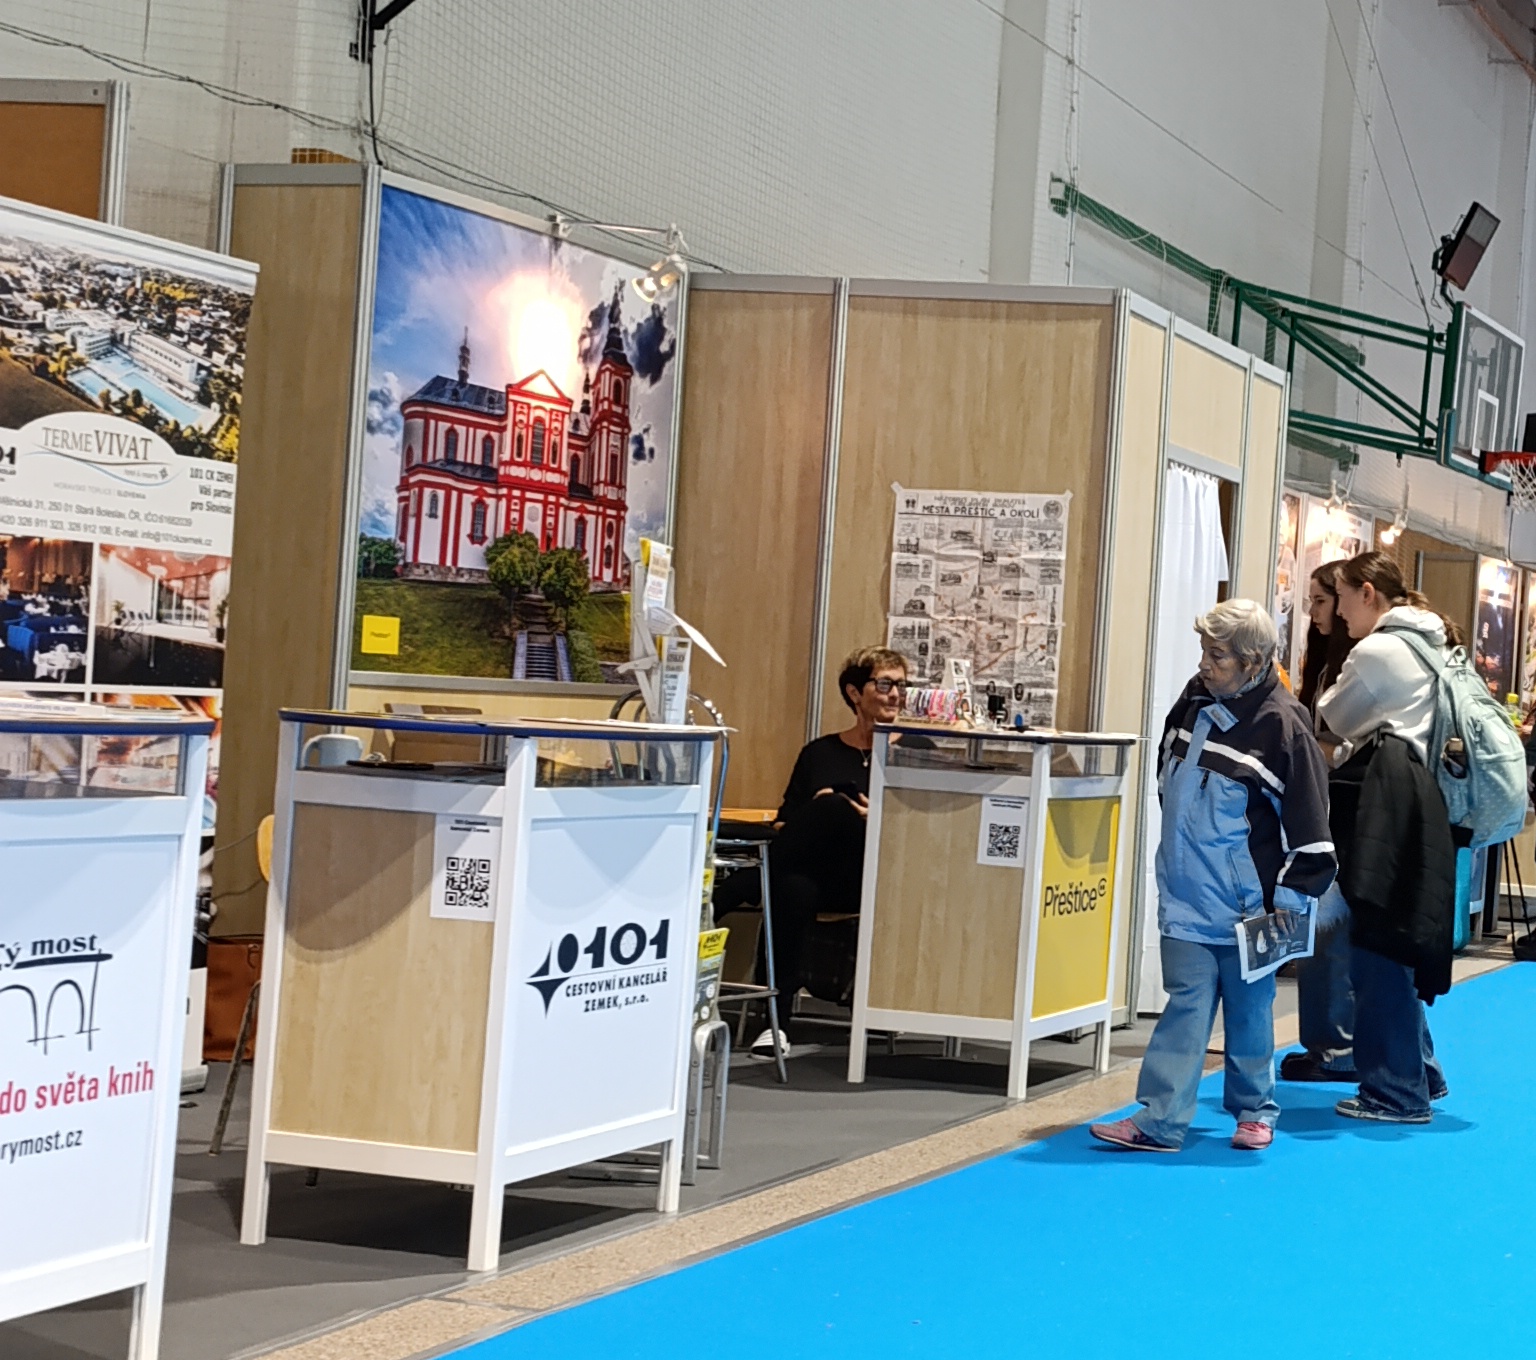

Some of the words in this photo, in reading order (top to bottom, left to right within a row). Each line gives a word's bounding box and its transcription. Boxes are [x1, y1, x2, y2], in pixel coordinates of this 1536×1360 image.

[922, 504, 950, 514] MĚSTA
[954, 505, 996, 517] PŘEŠTIC
[1000, 508, 1006, 517] A
[1009, 507, 1040, 519] OKOLÍ
[1043, 880, 1097, 918] Přeštice
[31, 934, 99, 956] most
[584, 918, 670, 969] 101
[565, 974, 616, 998] CESTOVNÍ
[618, 967, 668, 989] KANCELÁŘ
[584, 994, 622, 1013] ZEMEK,
[624, 993, 649, 1007] s.r.o.
[0, 1080, 27, 1116] do
[35, 1070, 99, 1110] světa
[107, 1060, 154, 1098] knih
